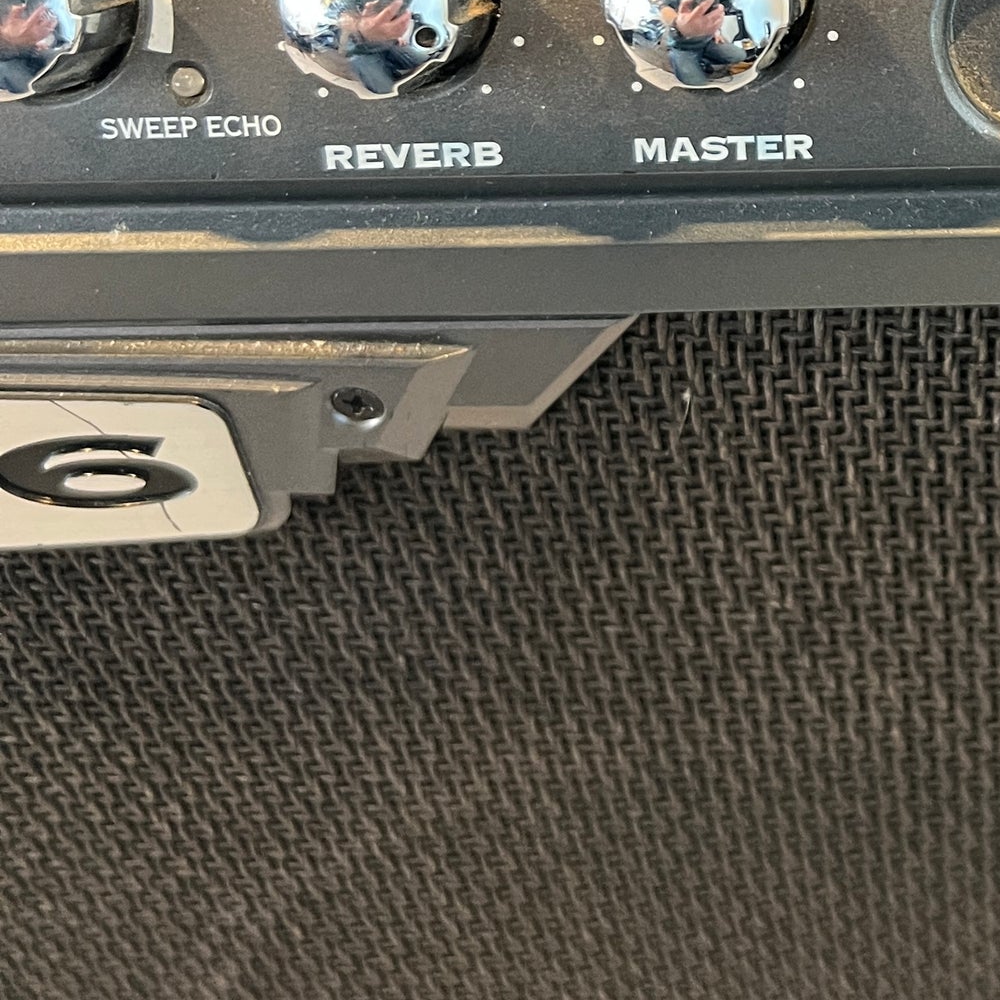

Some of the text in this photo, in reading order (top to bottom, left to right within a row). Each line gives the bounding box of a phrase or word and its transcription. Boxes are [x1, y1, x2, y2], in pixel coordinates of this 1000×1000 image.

[100, 114, 282, 141] SWEEP ECHO
[324, 141, 504, 171] REVERB
[633, 134, 814, 165] MASTER
[0, 434, 199, 508] 6
